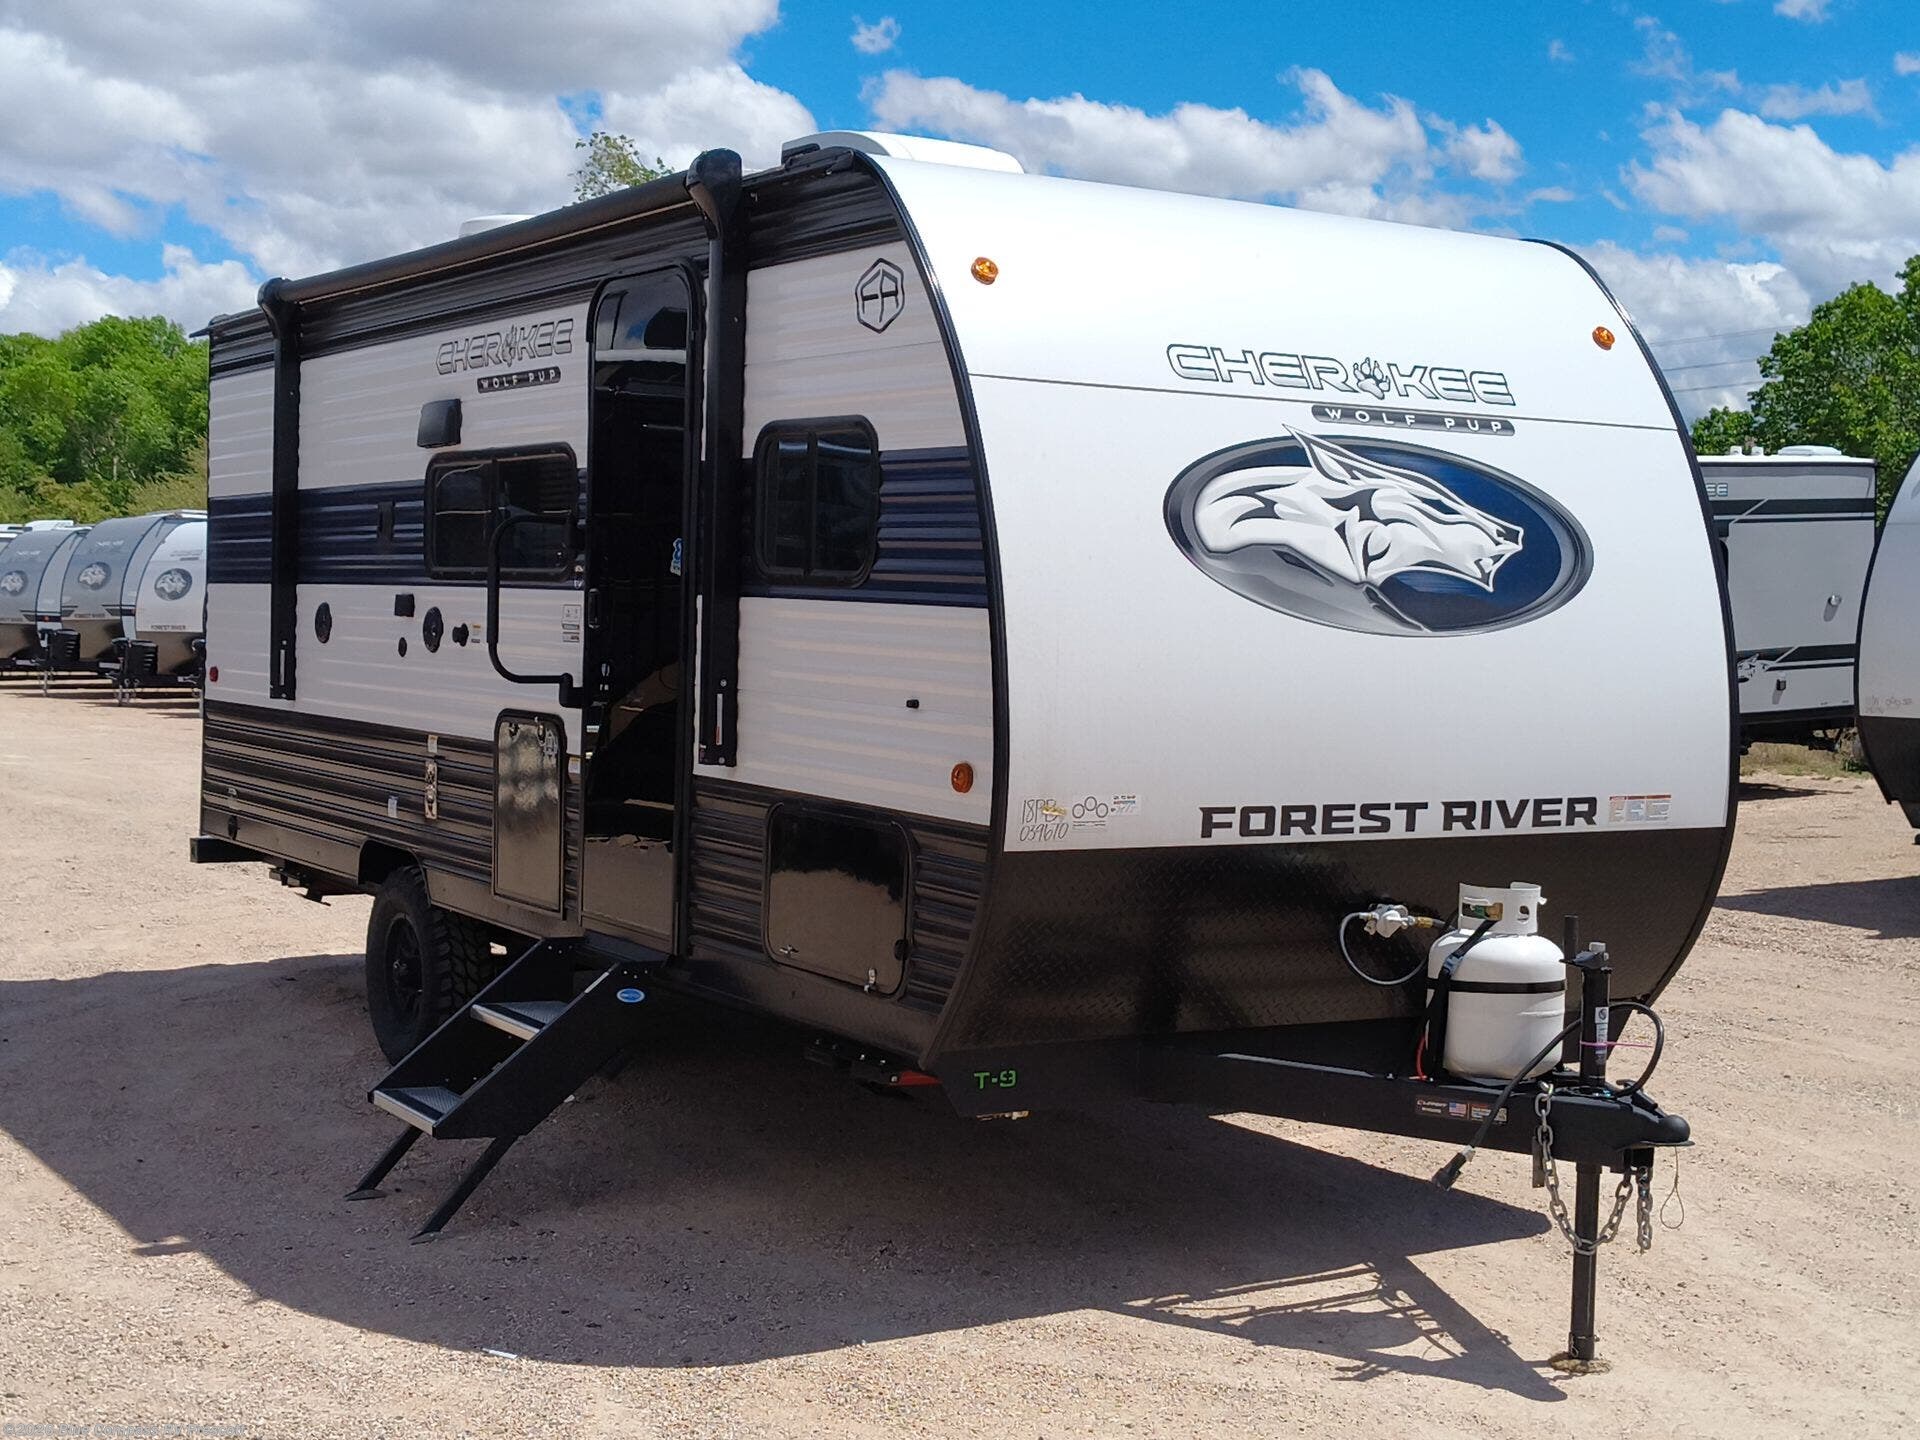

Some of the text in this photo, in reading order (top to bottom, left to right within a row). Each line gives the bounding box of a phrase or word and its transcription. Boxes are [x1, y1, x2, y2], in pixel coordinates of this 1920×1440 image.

[480, 369, 557, 389] WOLF PUP
[1324, 407, 1502, 434] WOLF PUP
[1199, 801, 1429, 838] FOREST
[1441, 795, 1598, 831] RIVER
